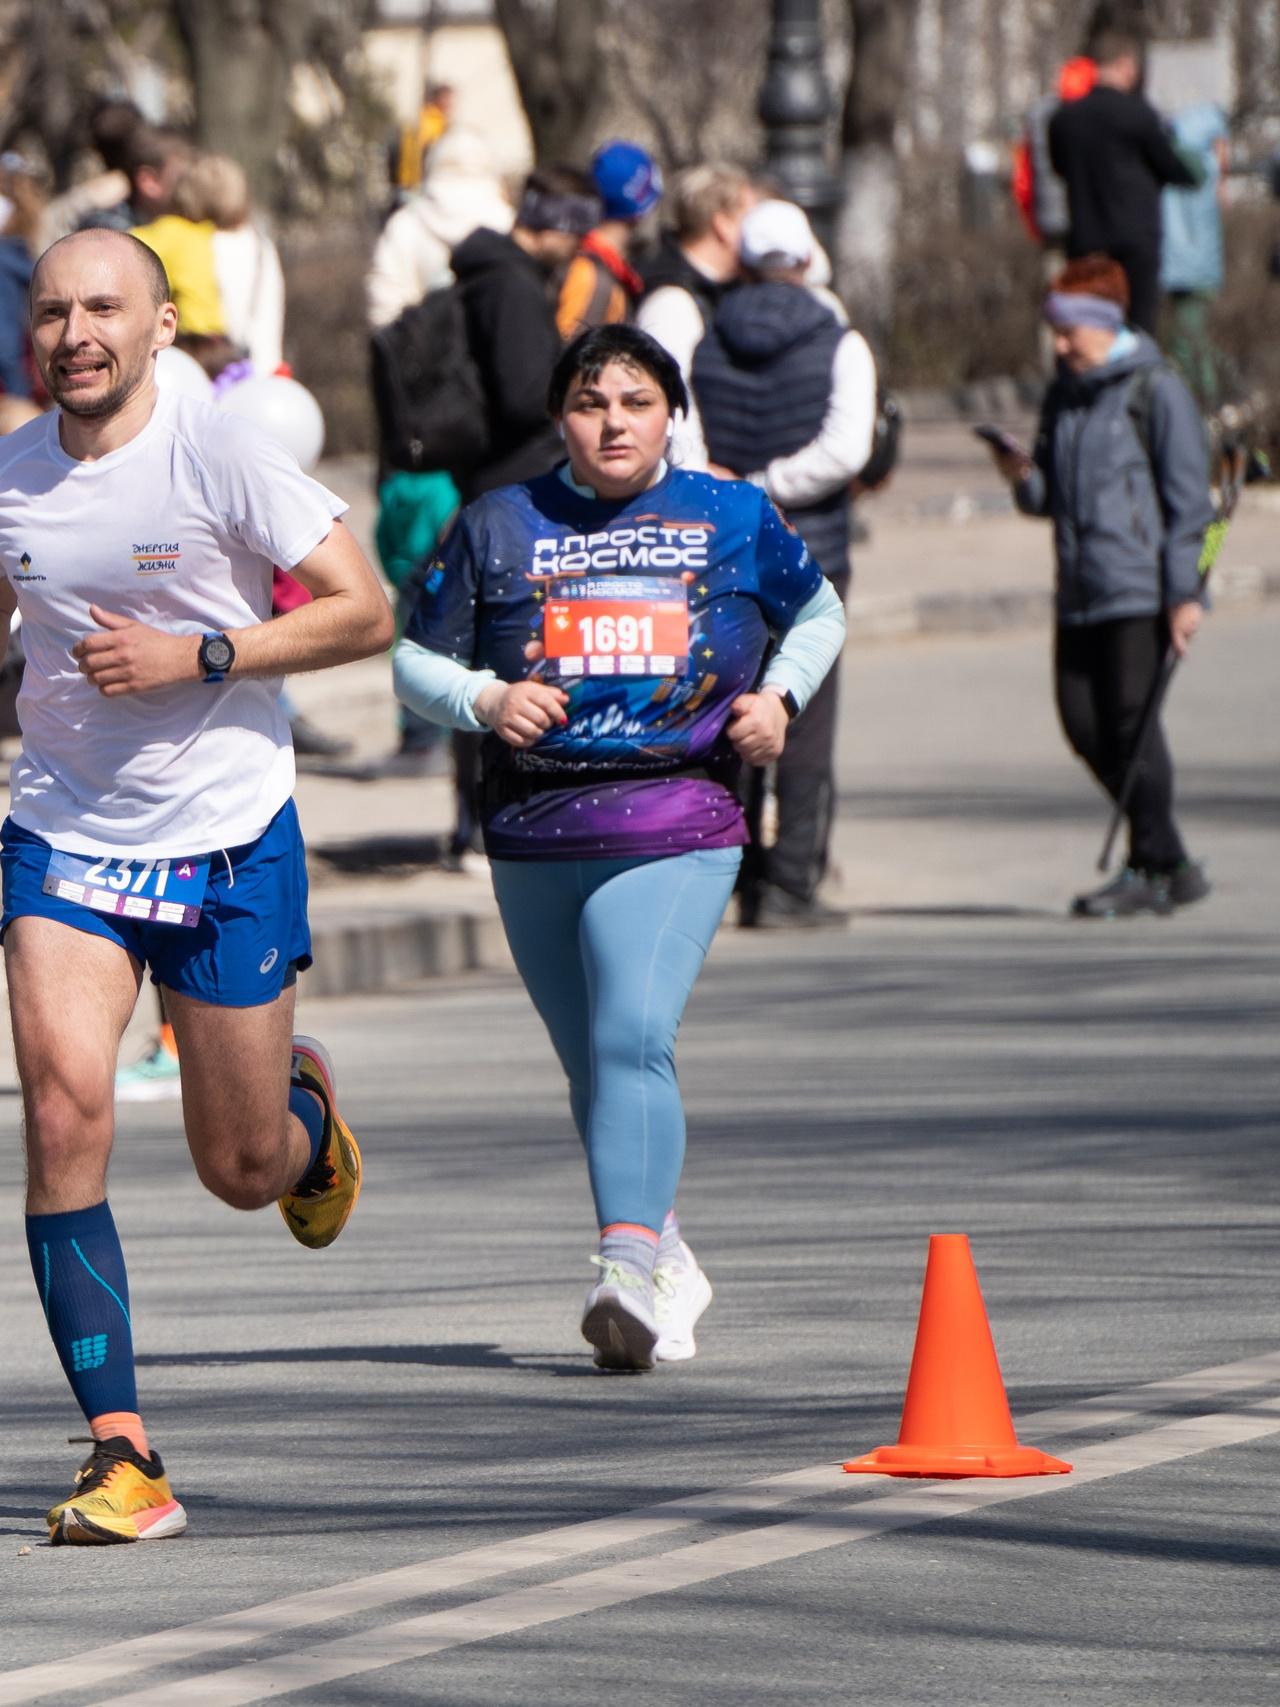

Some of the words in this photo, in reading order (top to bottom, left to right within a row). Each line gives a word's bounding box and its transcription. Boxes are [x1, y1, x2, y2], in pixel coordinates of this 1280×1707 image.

[132, 543, 179, 554] ЭНЕРГИЯ
[534, 539, 558, 555] Я
[564, 526, 708, 552] ПРОСТО
[137, 560, 176, 571] ЖИЗНИ
[532, 546, 708, 575] КОСМОС
[579, 615, 654, 653] 1691
[84, 856, 171, 897] 2371
[74, 1356, 106, 1372] cep
